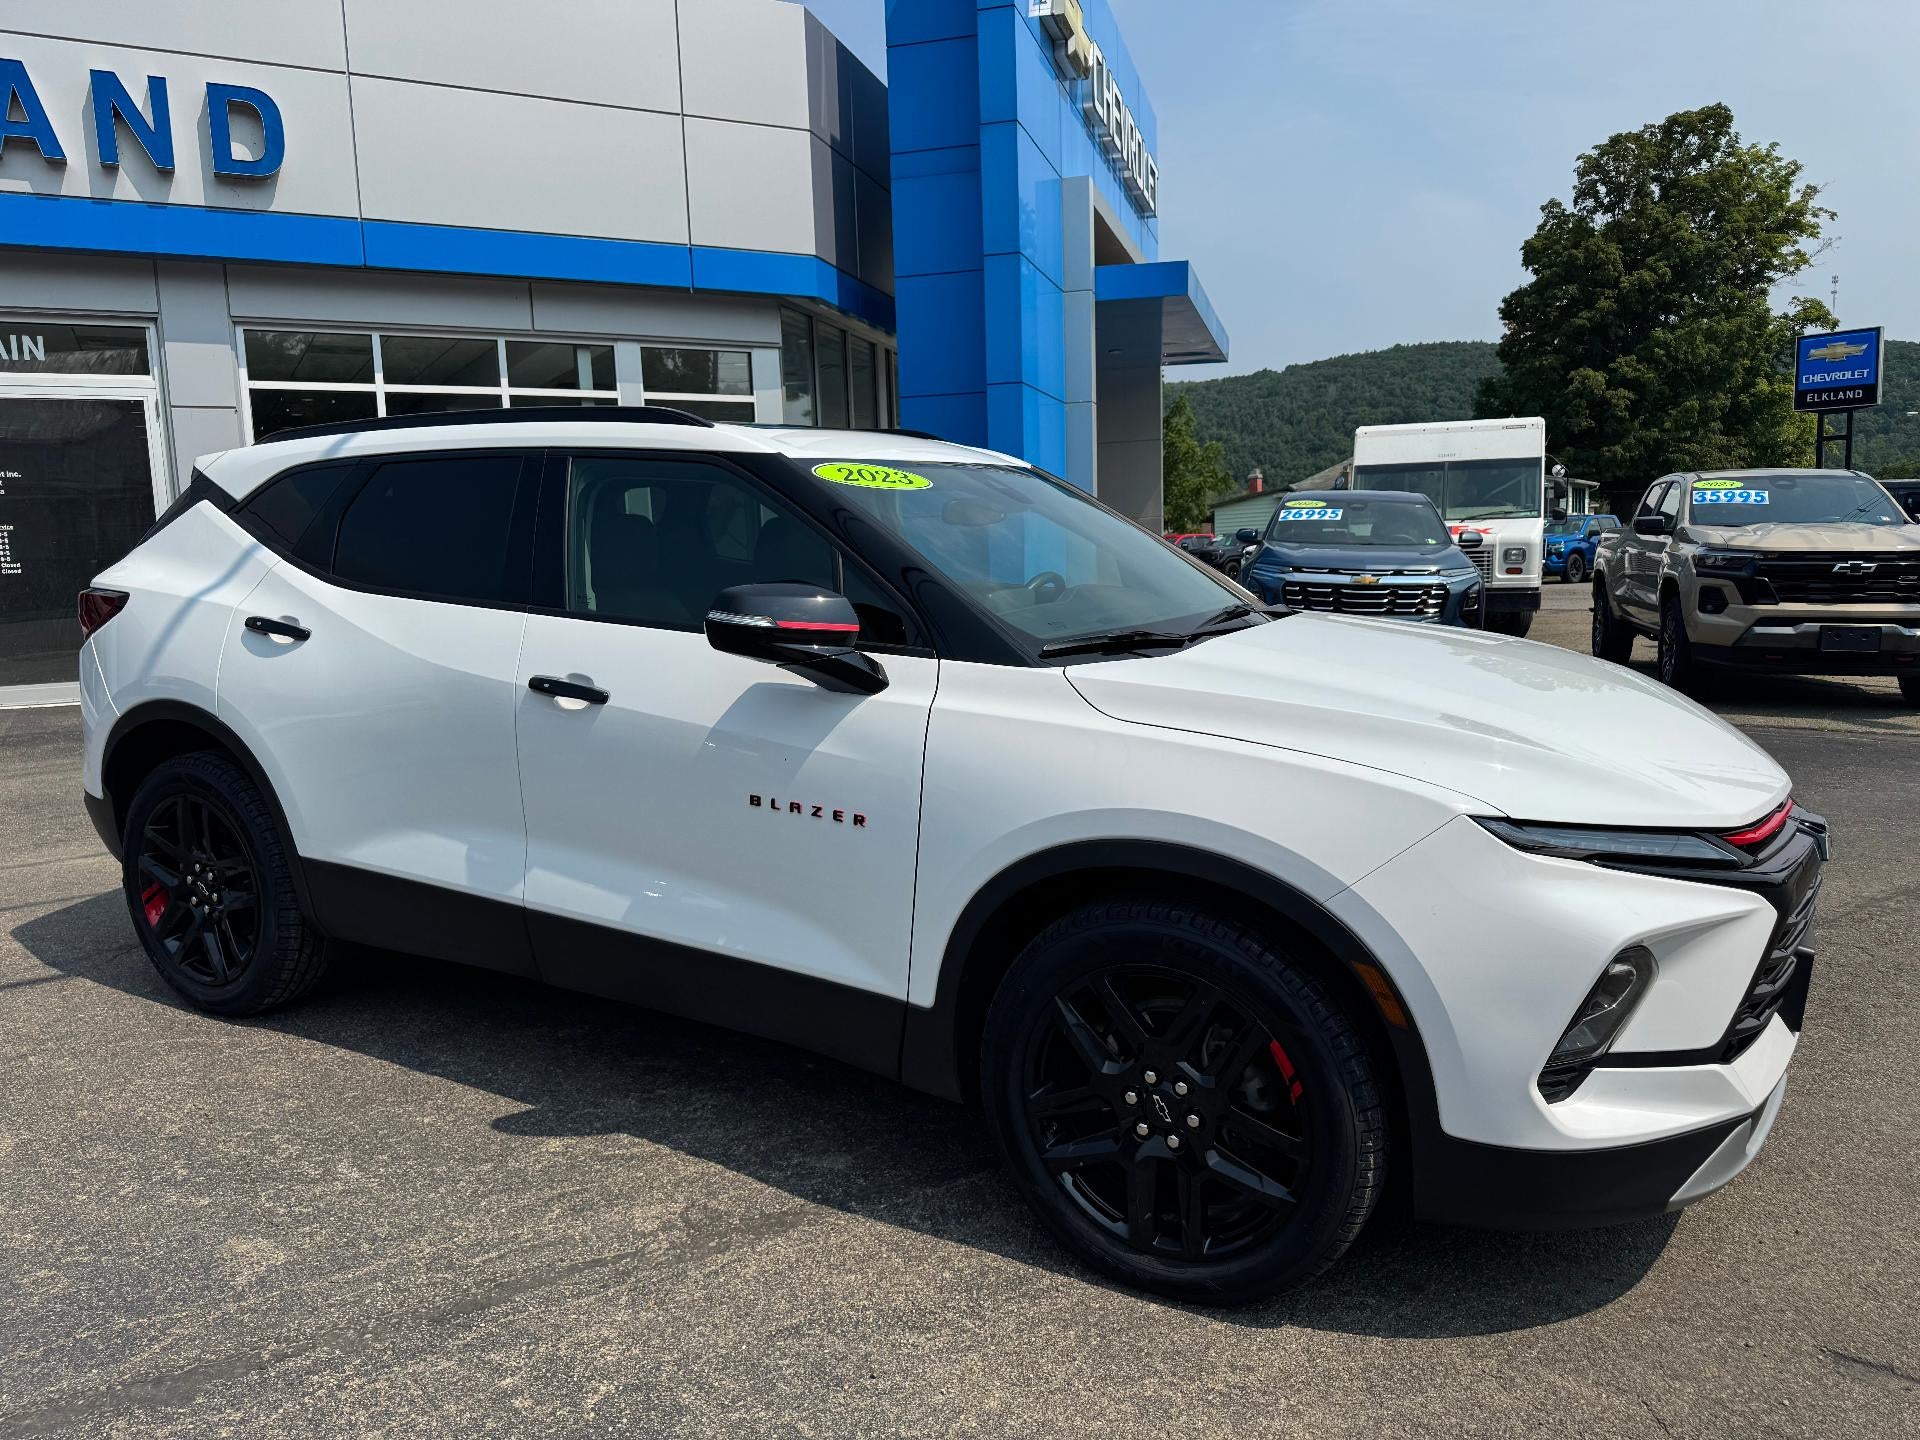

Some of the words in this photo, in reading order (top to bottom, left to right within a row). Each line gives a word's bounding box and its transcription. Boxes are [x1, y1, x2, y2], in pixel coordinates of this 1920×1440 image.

[1802, 368, 1870, 384] CHEVROLET
[1806, 389, 1863, 402] ELKLAND
[837, 467, 914, 485] 2023
[1693, 491, 1767, 503] 35995
[1280, 509, 1341, 520] 26995
[749, 794, 867, 828] BLAZER
